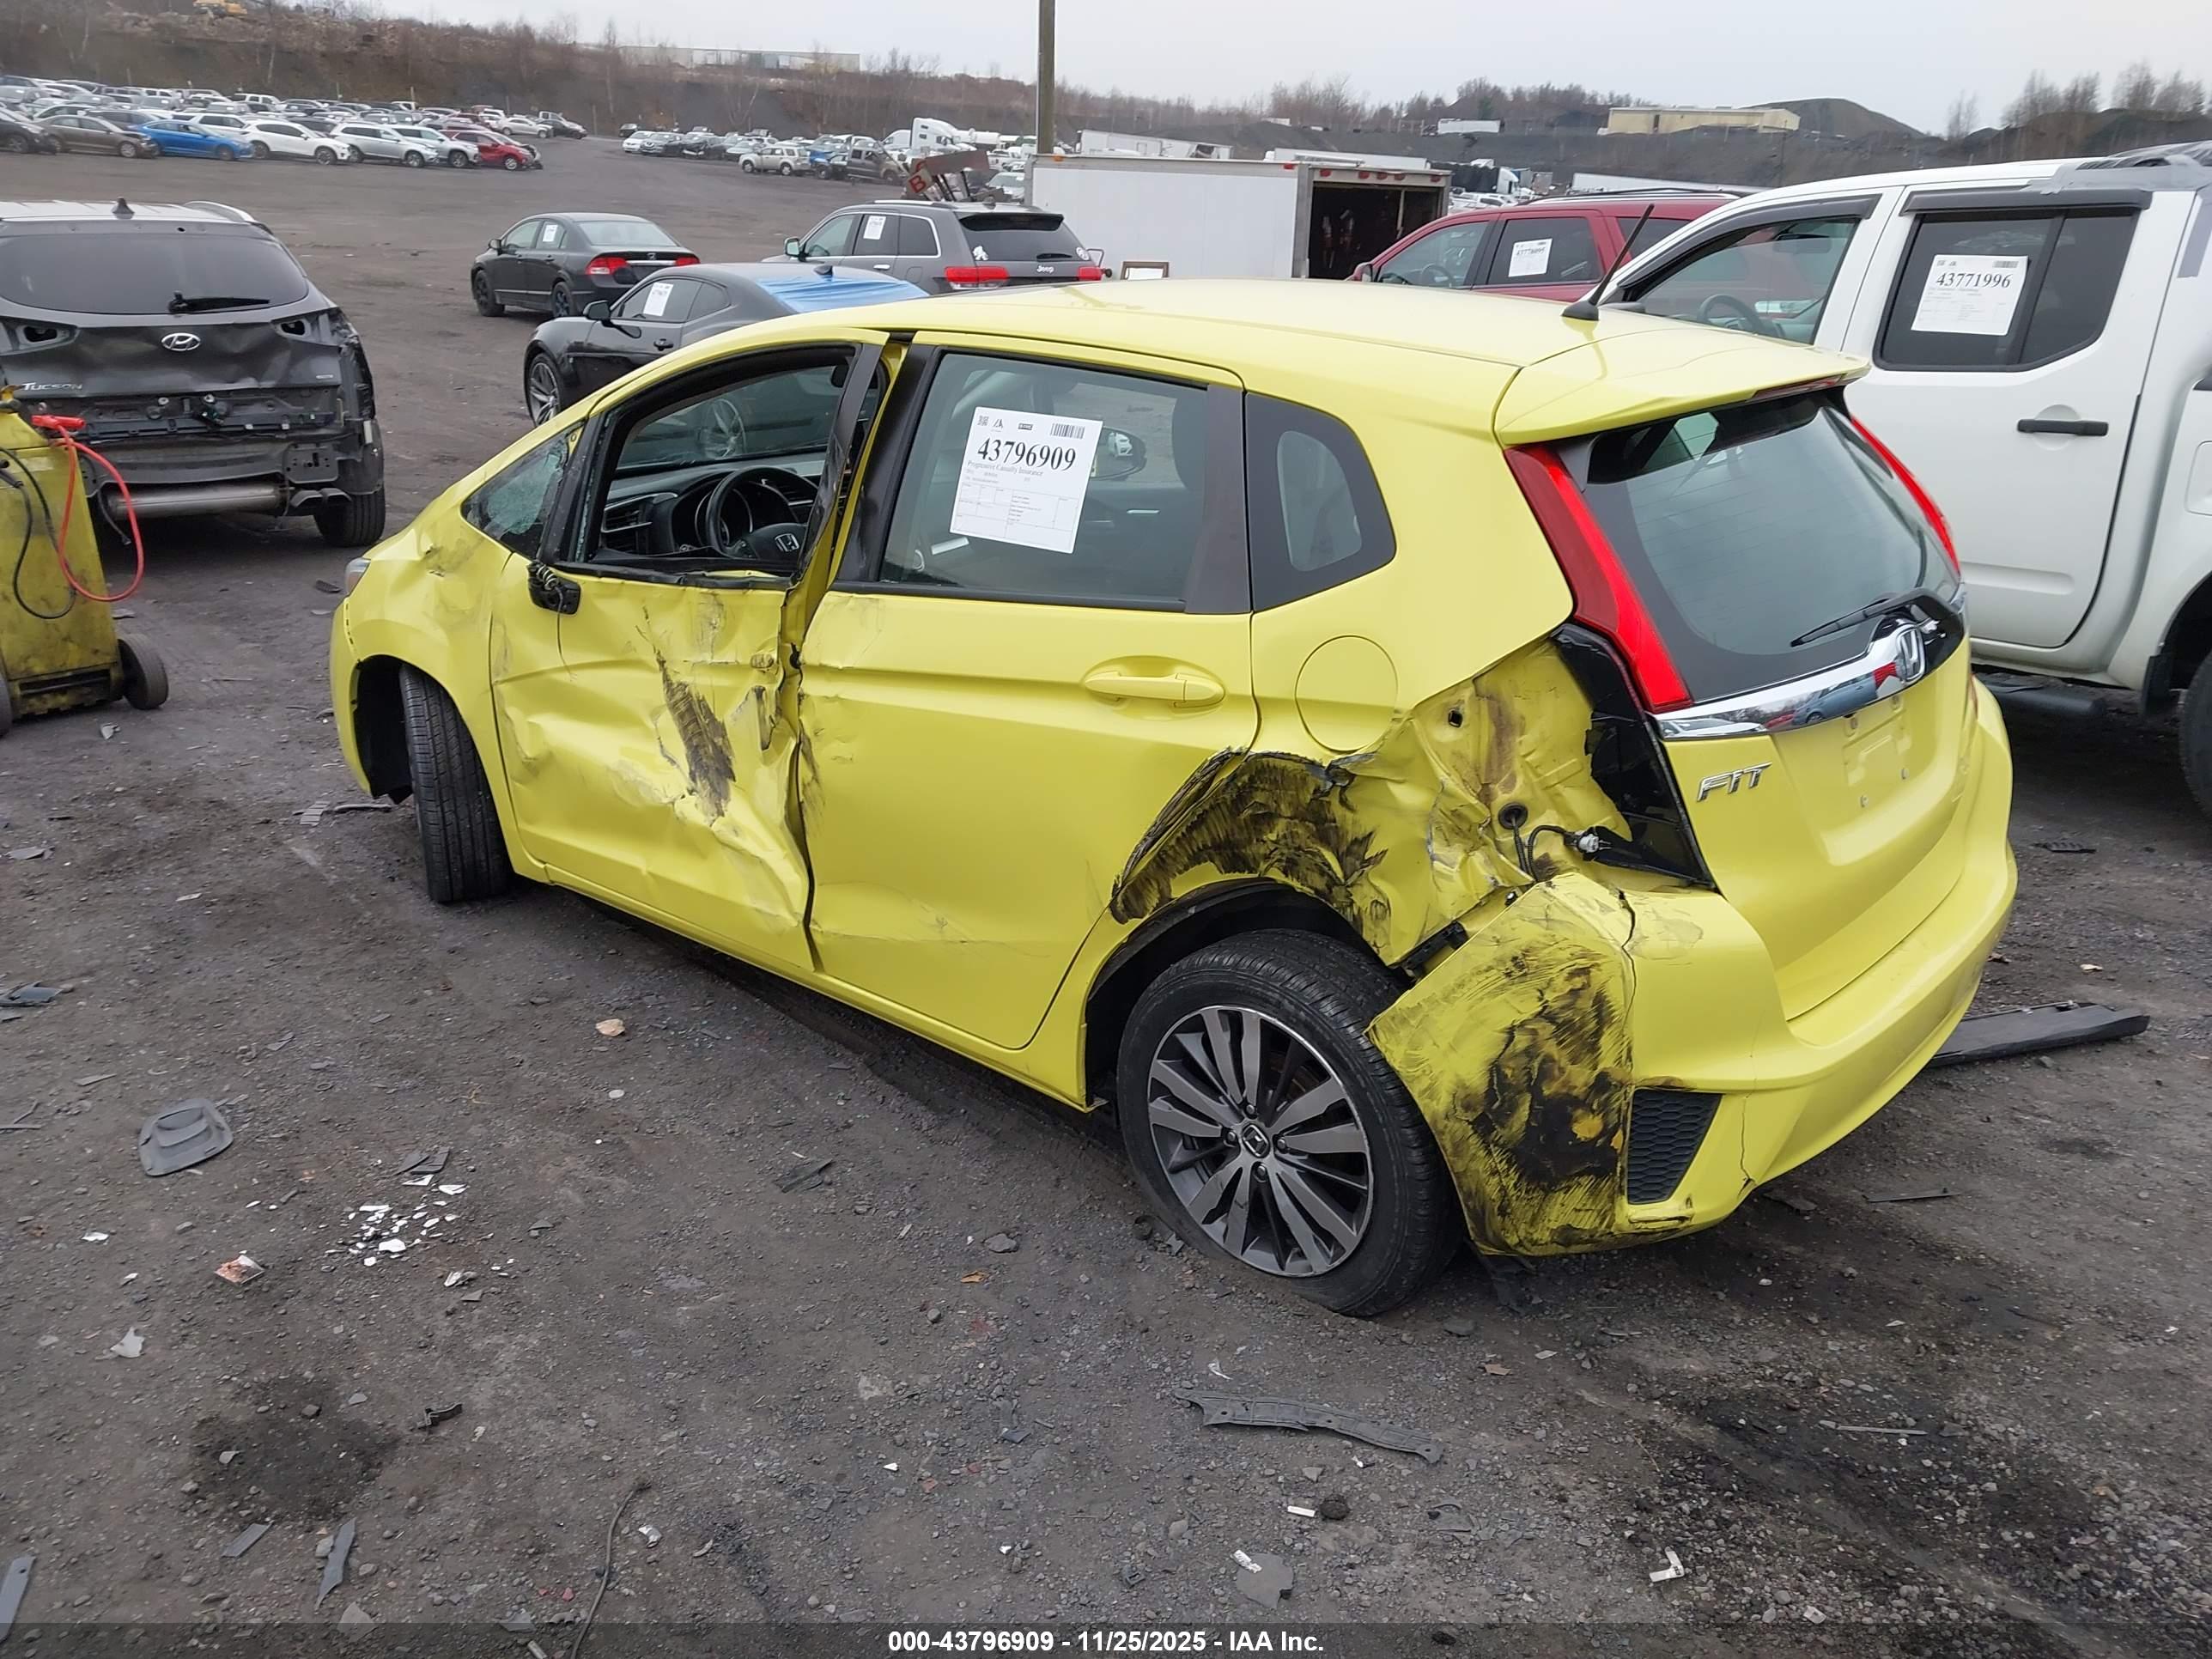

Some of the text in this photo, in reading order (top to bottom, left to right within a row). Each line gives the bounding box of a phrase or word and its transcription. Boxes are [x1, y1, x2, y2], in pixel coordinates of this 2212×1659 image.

[1036, 264, 1055, 274] Jeep
[1936, 271, 2013, 289] 43771996
[977, 437, 1076, 471] 43796909
[1696, 761, 1773, 803] FIT
